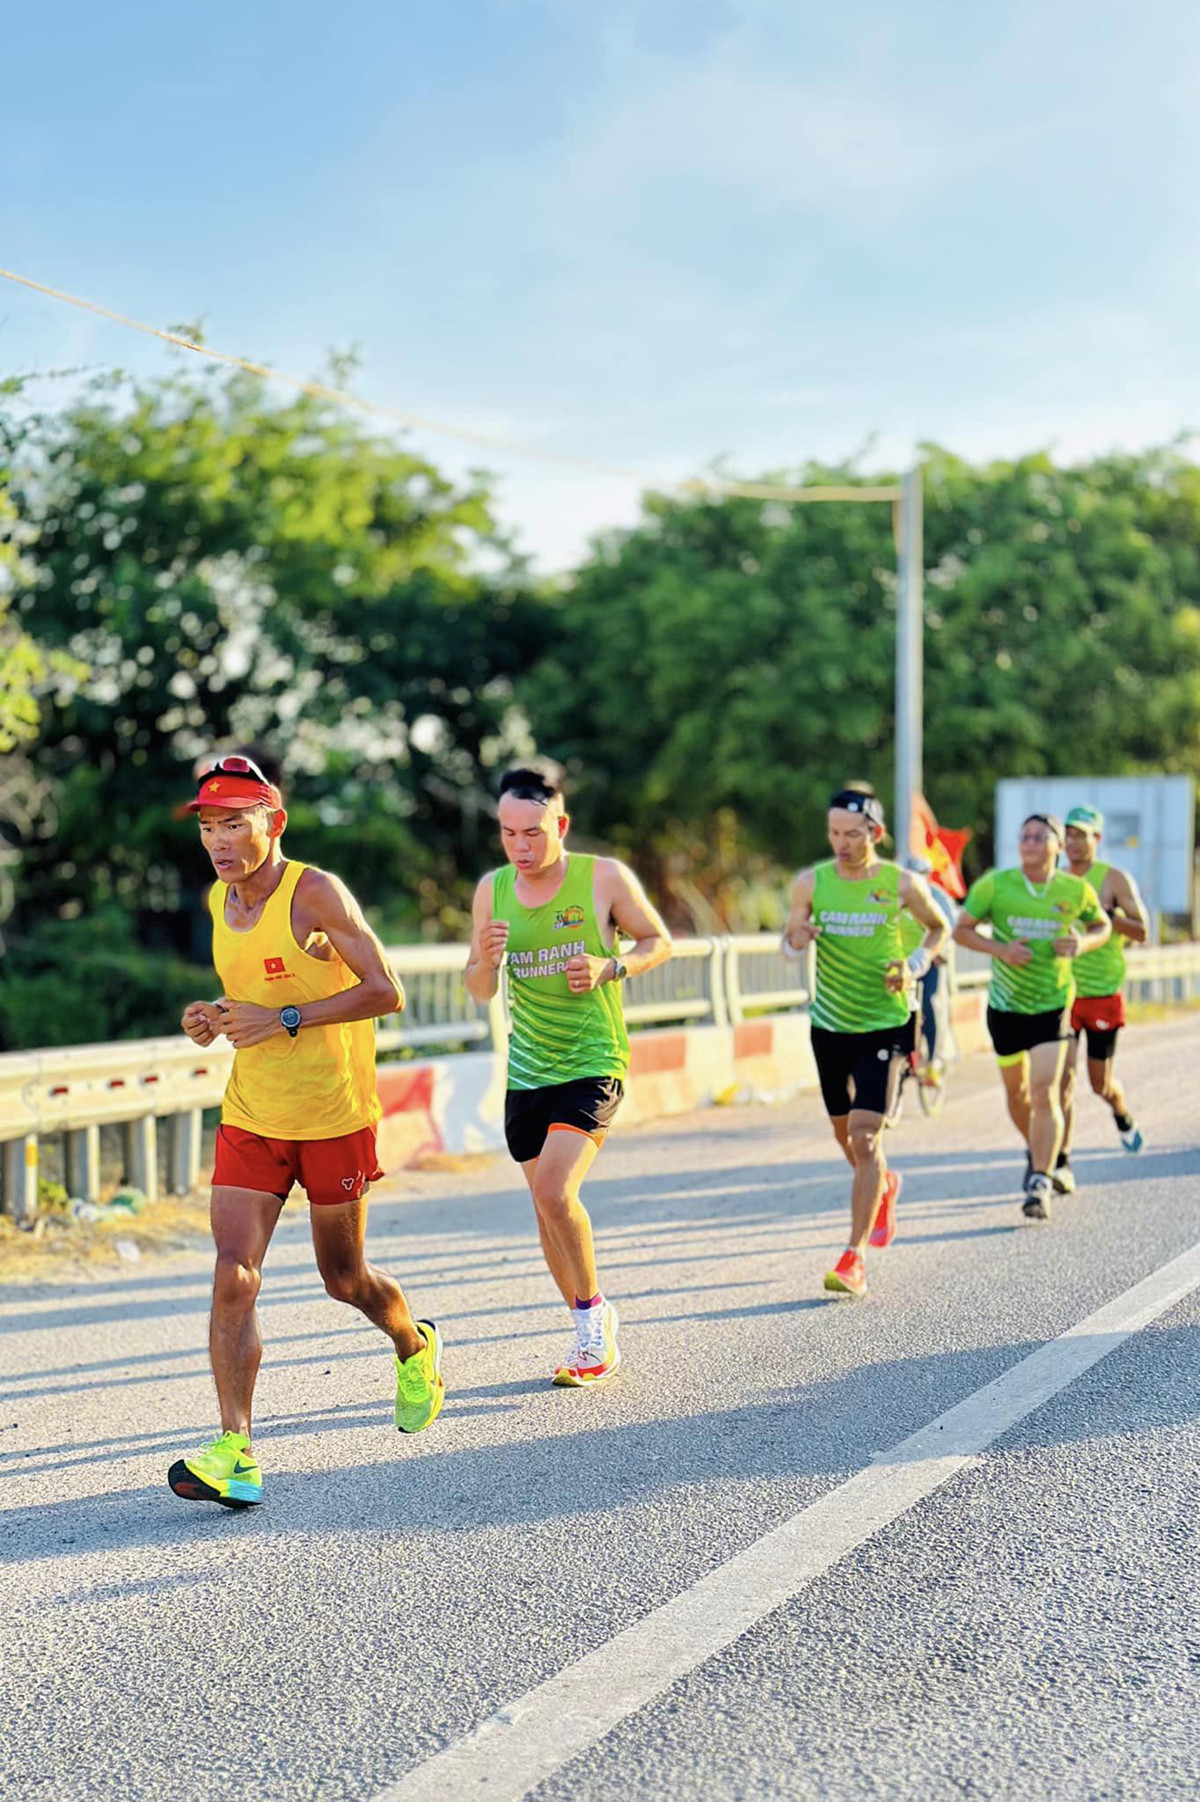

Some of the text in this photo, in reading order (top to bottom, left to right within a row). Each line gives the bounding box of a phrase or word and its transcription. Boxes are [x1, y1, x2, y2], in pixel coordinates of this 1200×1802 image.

[508, 940, 585, 965] AM RANH
[513, 961, 569, 979] RUNNER
